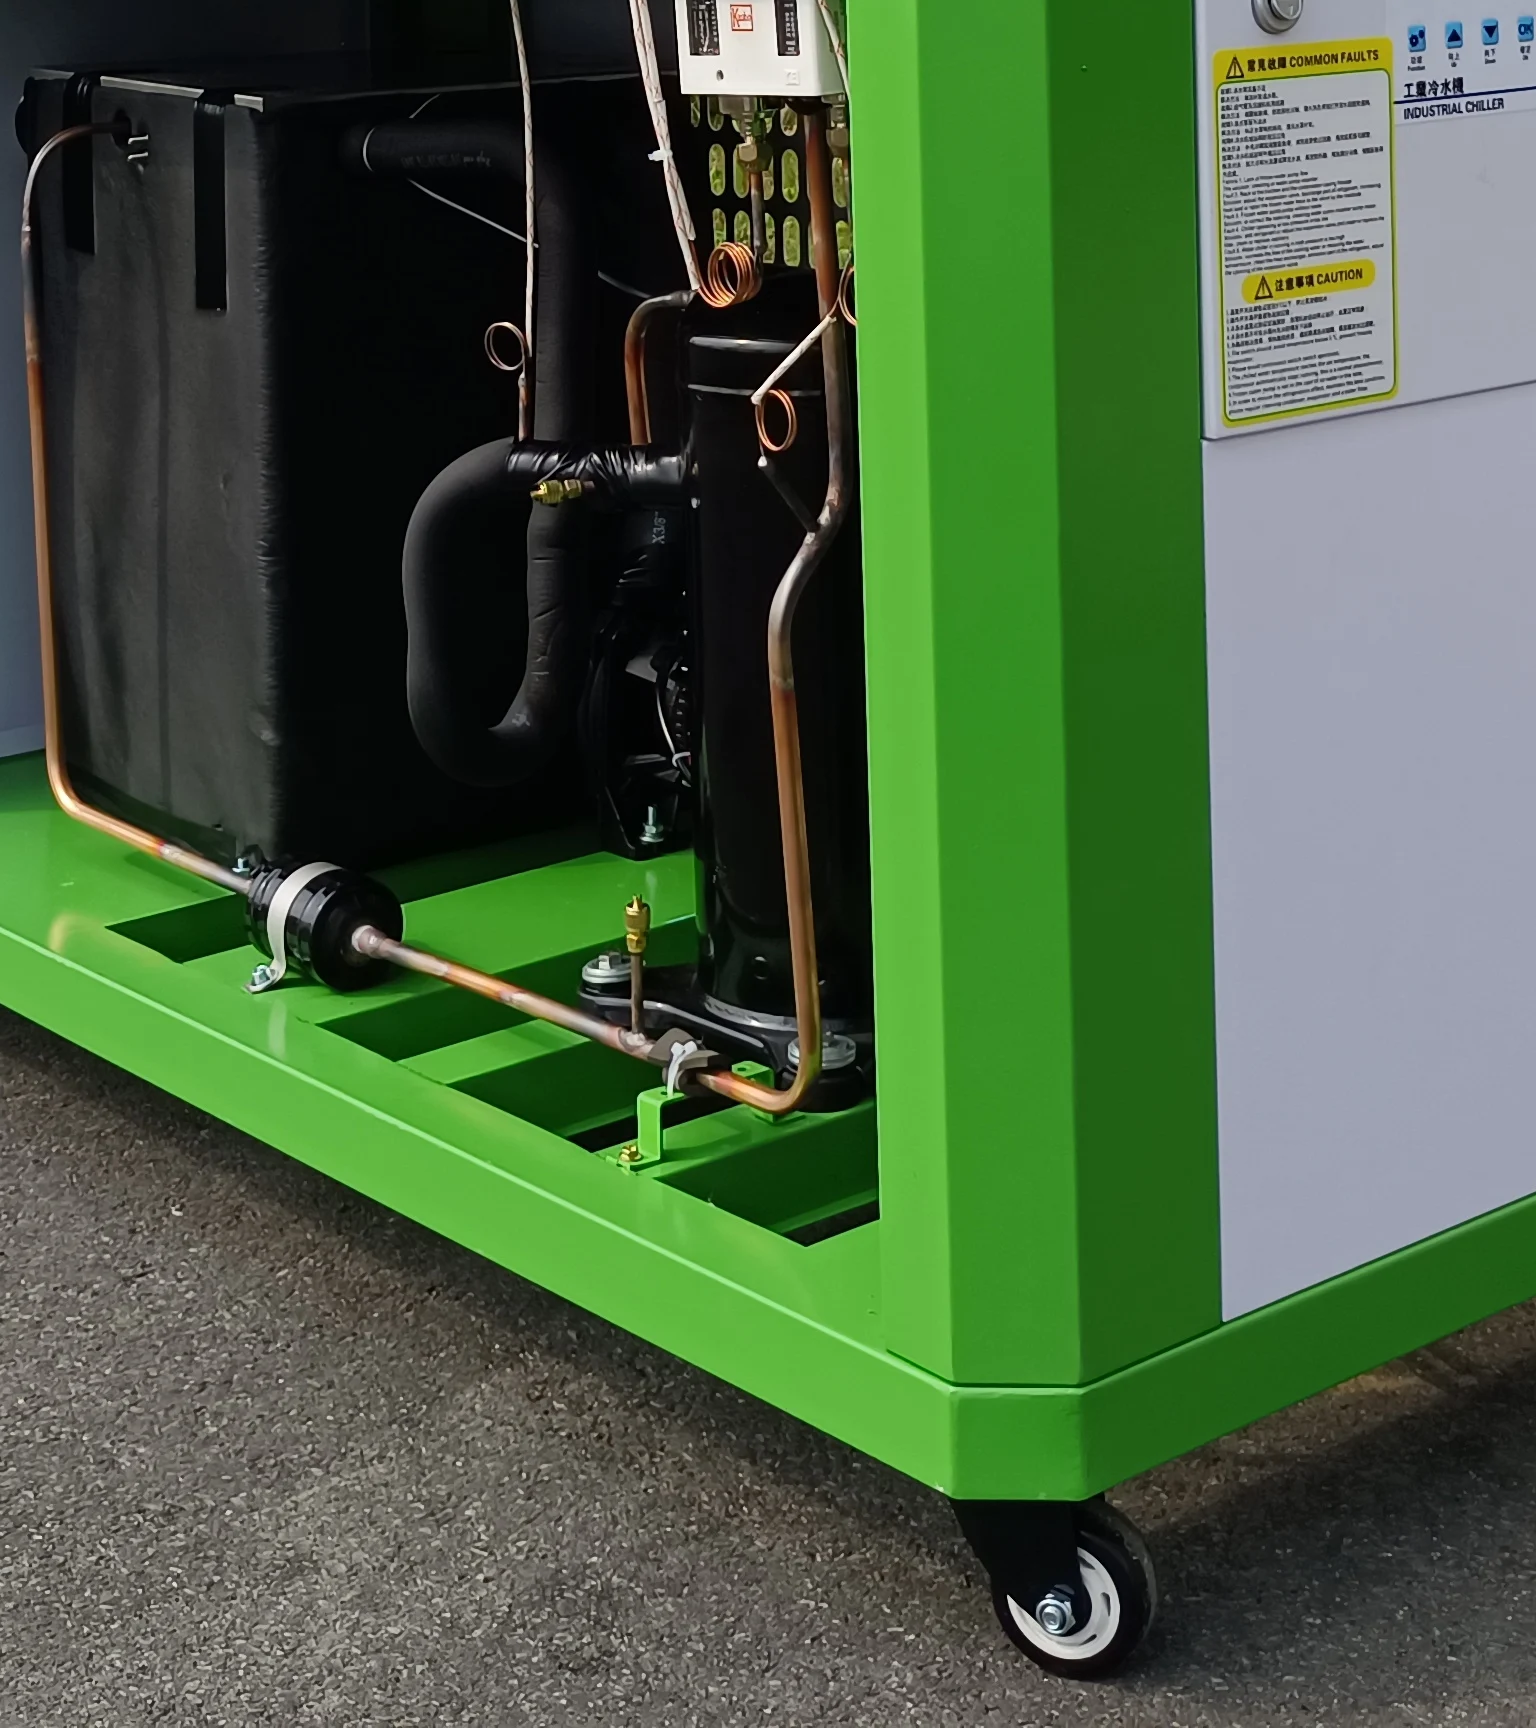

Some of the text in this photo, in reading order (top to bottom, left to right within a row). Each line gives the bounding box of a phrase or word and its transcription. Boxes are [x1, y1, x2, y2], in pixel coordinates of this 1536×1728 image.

[1289, 52, 1339, 68] COMMON
[1340, 49, 1379, 64] FAULTS
[1403, 97, 1505, 120] INDUSTRIAL CHILLER
[1316, 268, 1363, 285] CAUTION
